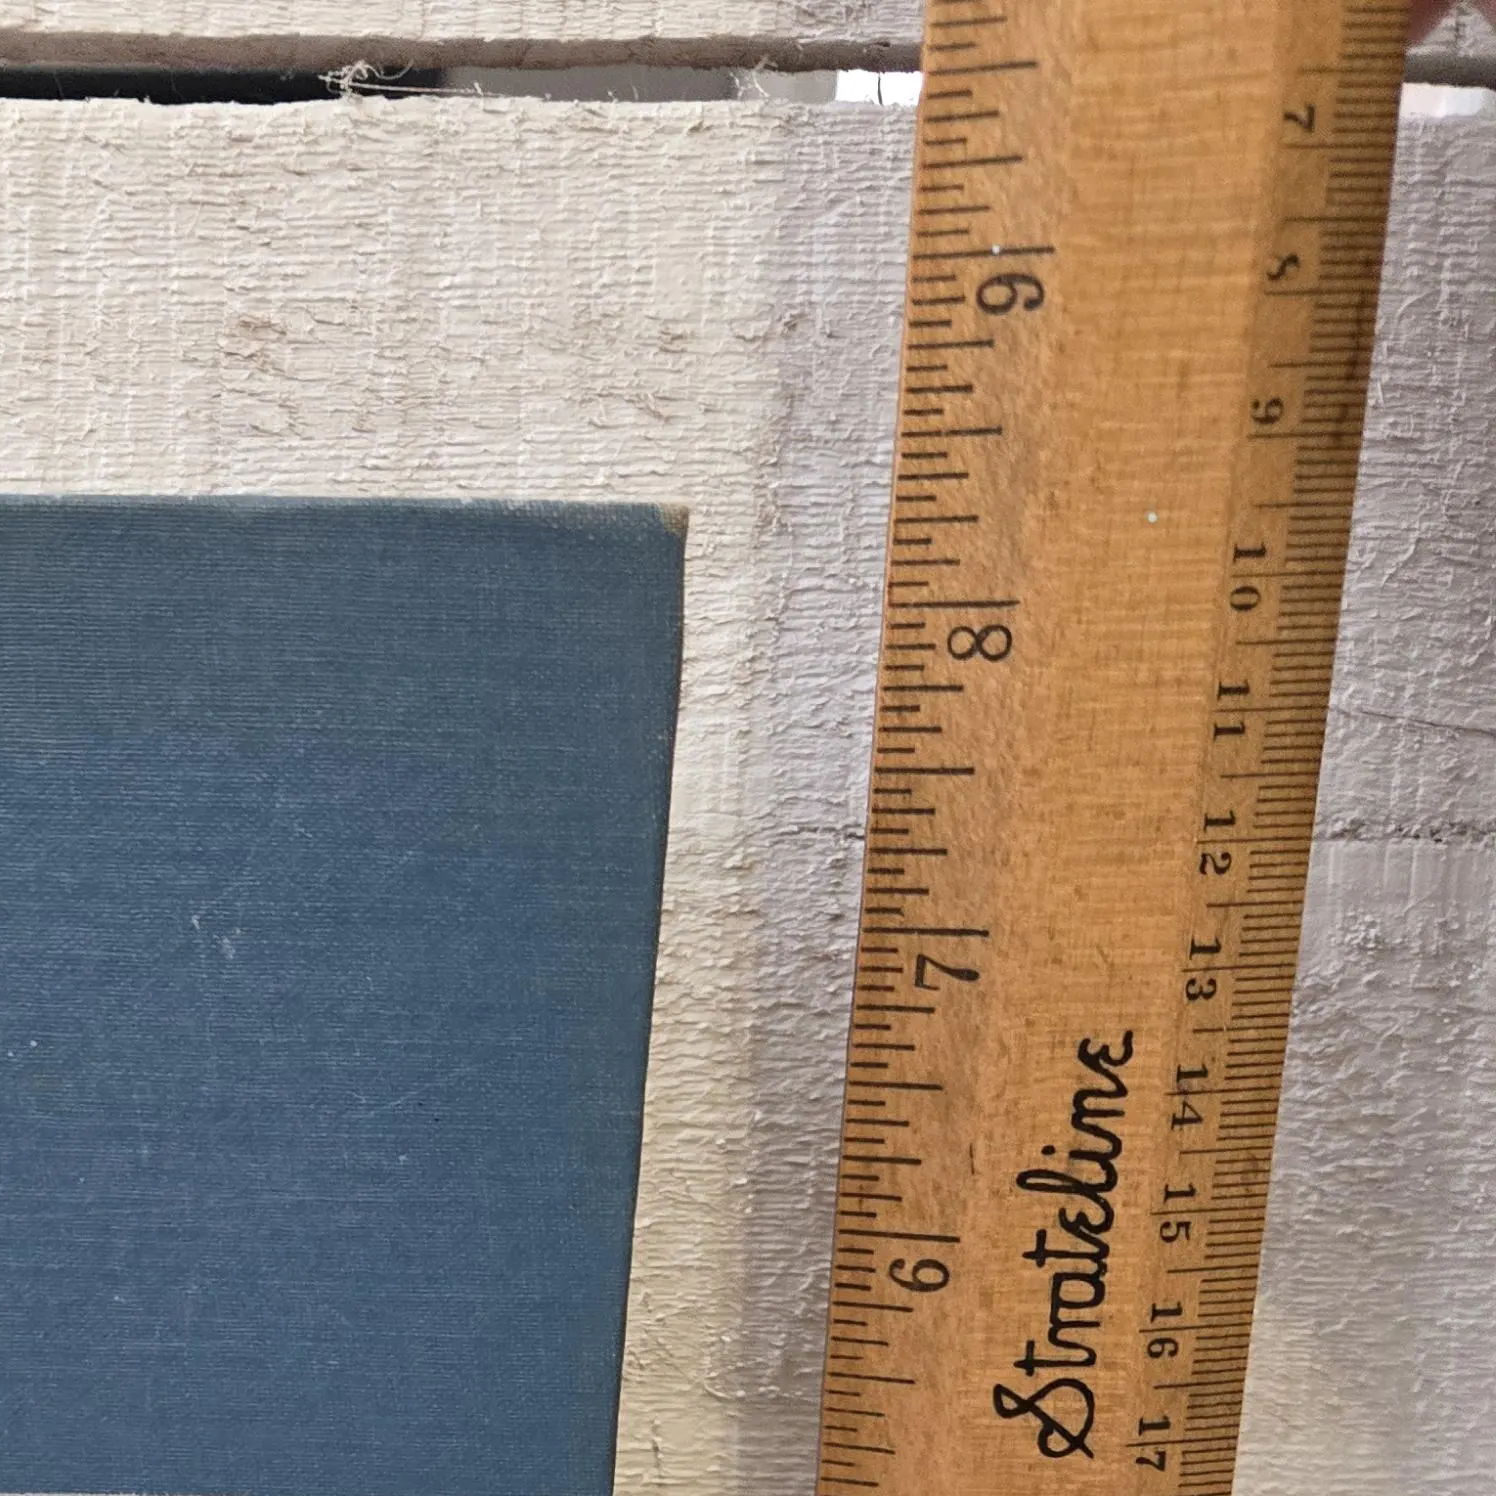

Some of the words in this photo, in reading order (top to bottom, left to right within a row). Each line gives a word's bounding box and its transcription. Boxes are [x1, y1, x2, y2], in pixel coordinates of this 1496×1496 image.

[1284, 105, 1314, 132] 7
[976, 271, 1045, 316] 9
[1251, 399, 1284, 425] 9
[1229, 542, 1266, 613] 10
[947, 624, 1012, 662] 8
[1213, 679, 1249, 740] 11
[1199, 810, 1235, 876] 12
[914, 954, 980, 991] 7
[1185, 936, 1221, 1001] 13
[1170, 1063, 1209, 1130] 14
[1159, 1182, 1197, 1244] 15
[993, 1030, 1134, 1459] Strateline
[889, 1258, 950, 1293] 6
[1147, 1301, 1183, 1360] 16
[1135, 1414, 1171, 1473] 17
